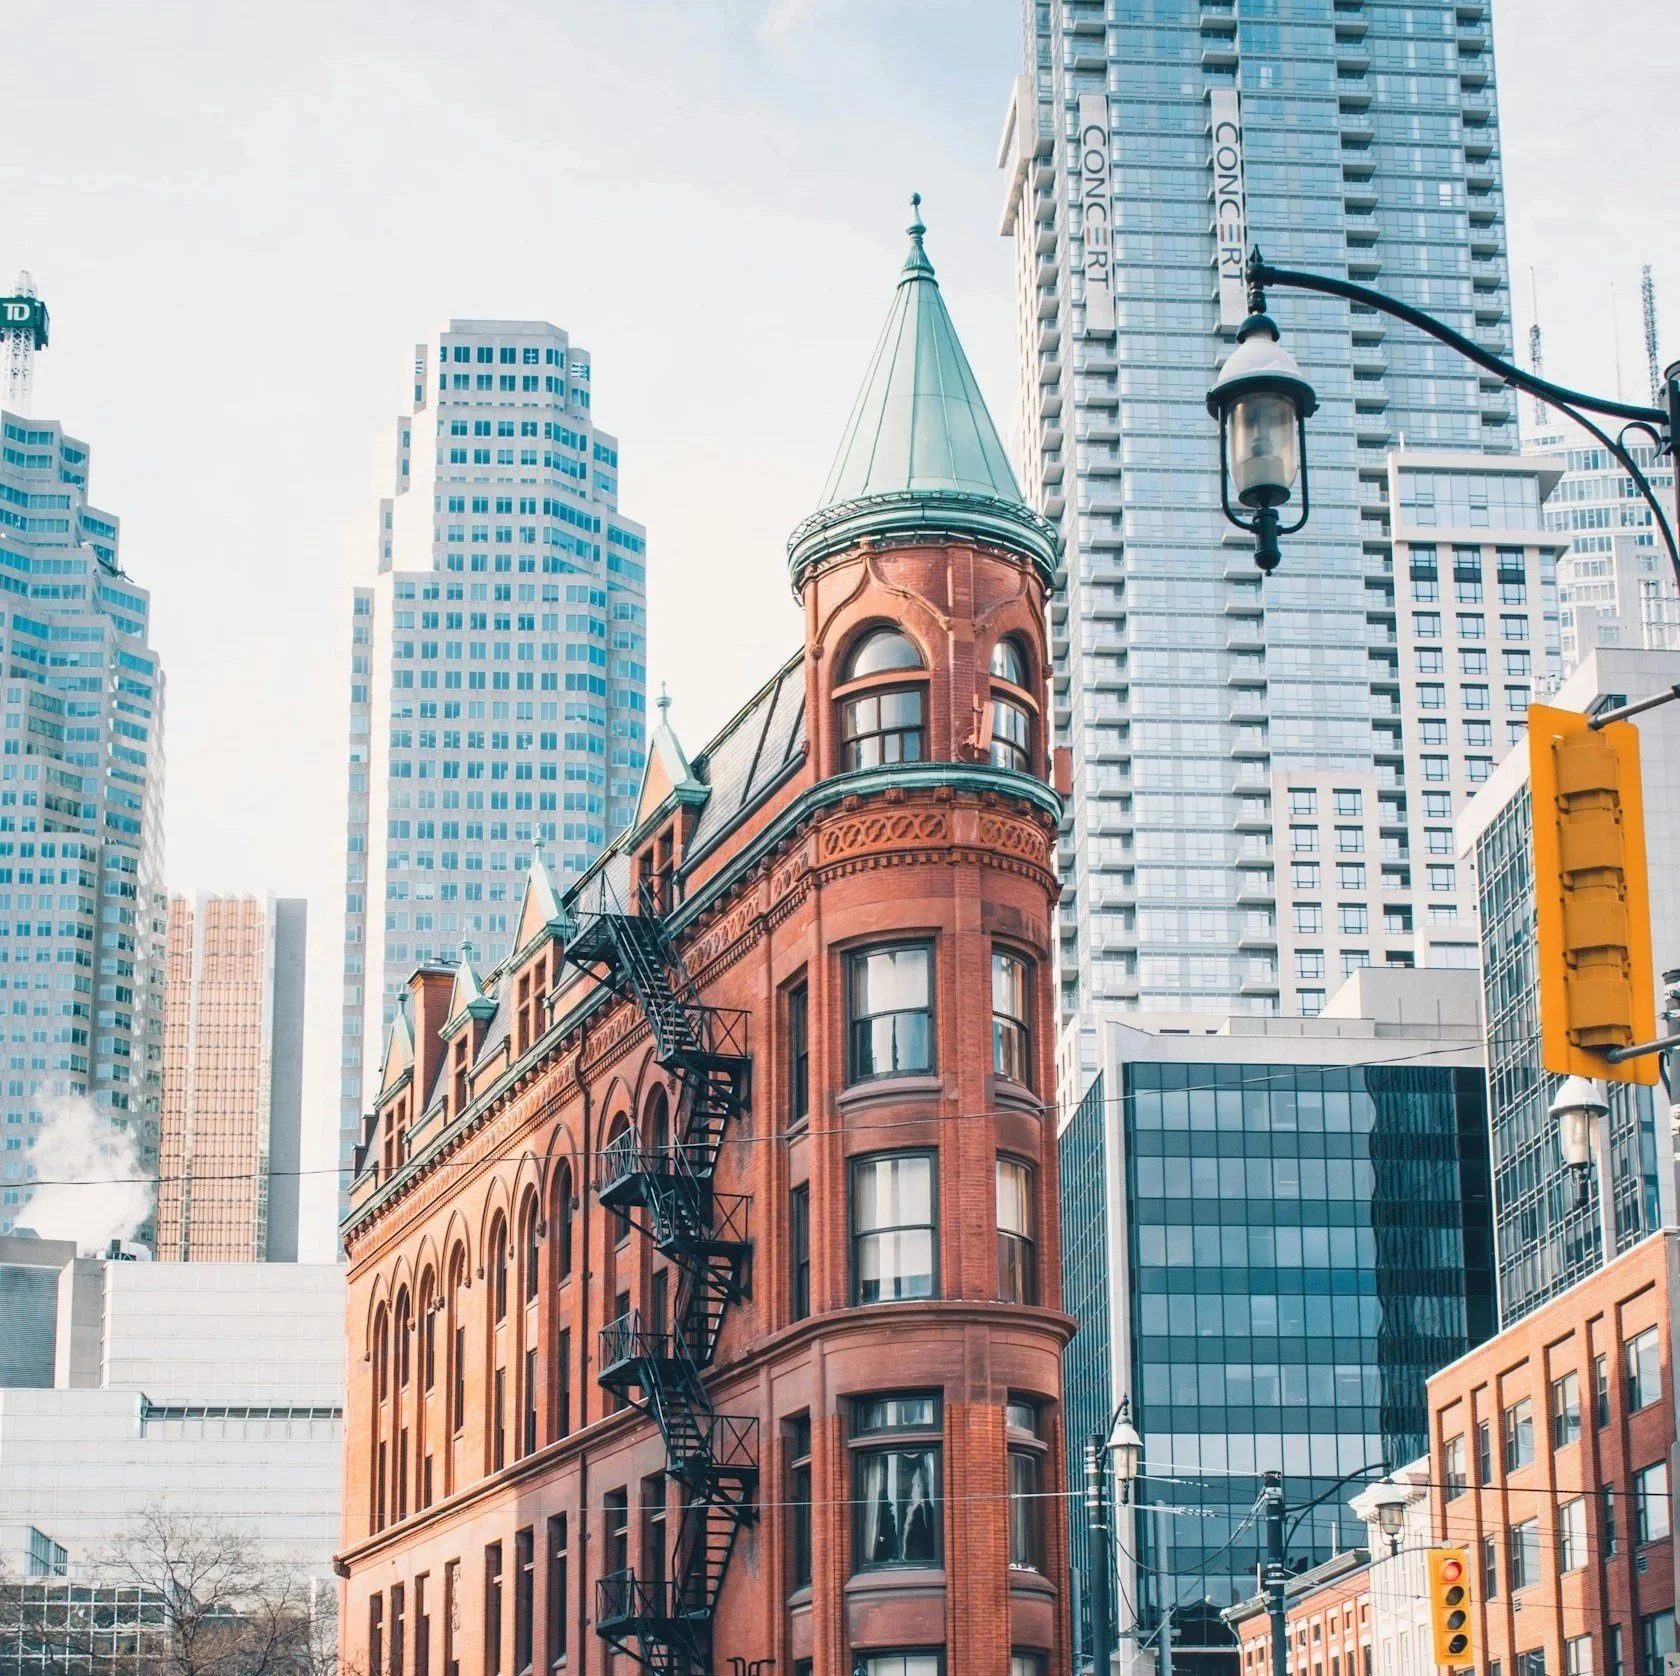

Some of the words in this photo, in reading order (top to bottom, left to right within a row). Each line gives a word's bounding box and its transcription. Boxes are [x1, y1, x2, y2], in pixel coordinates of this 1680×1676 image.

[1083, 125, 1109, 290] CONCERT
[1215, 121, 1243, 287] CONCERT
[2, 303, 30, 321] TD
